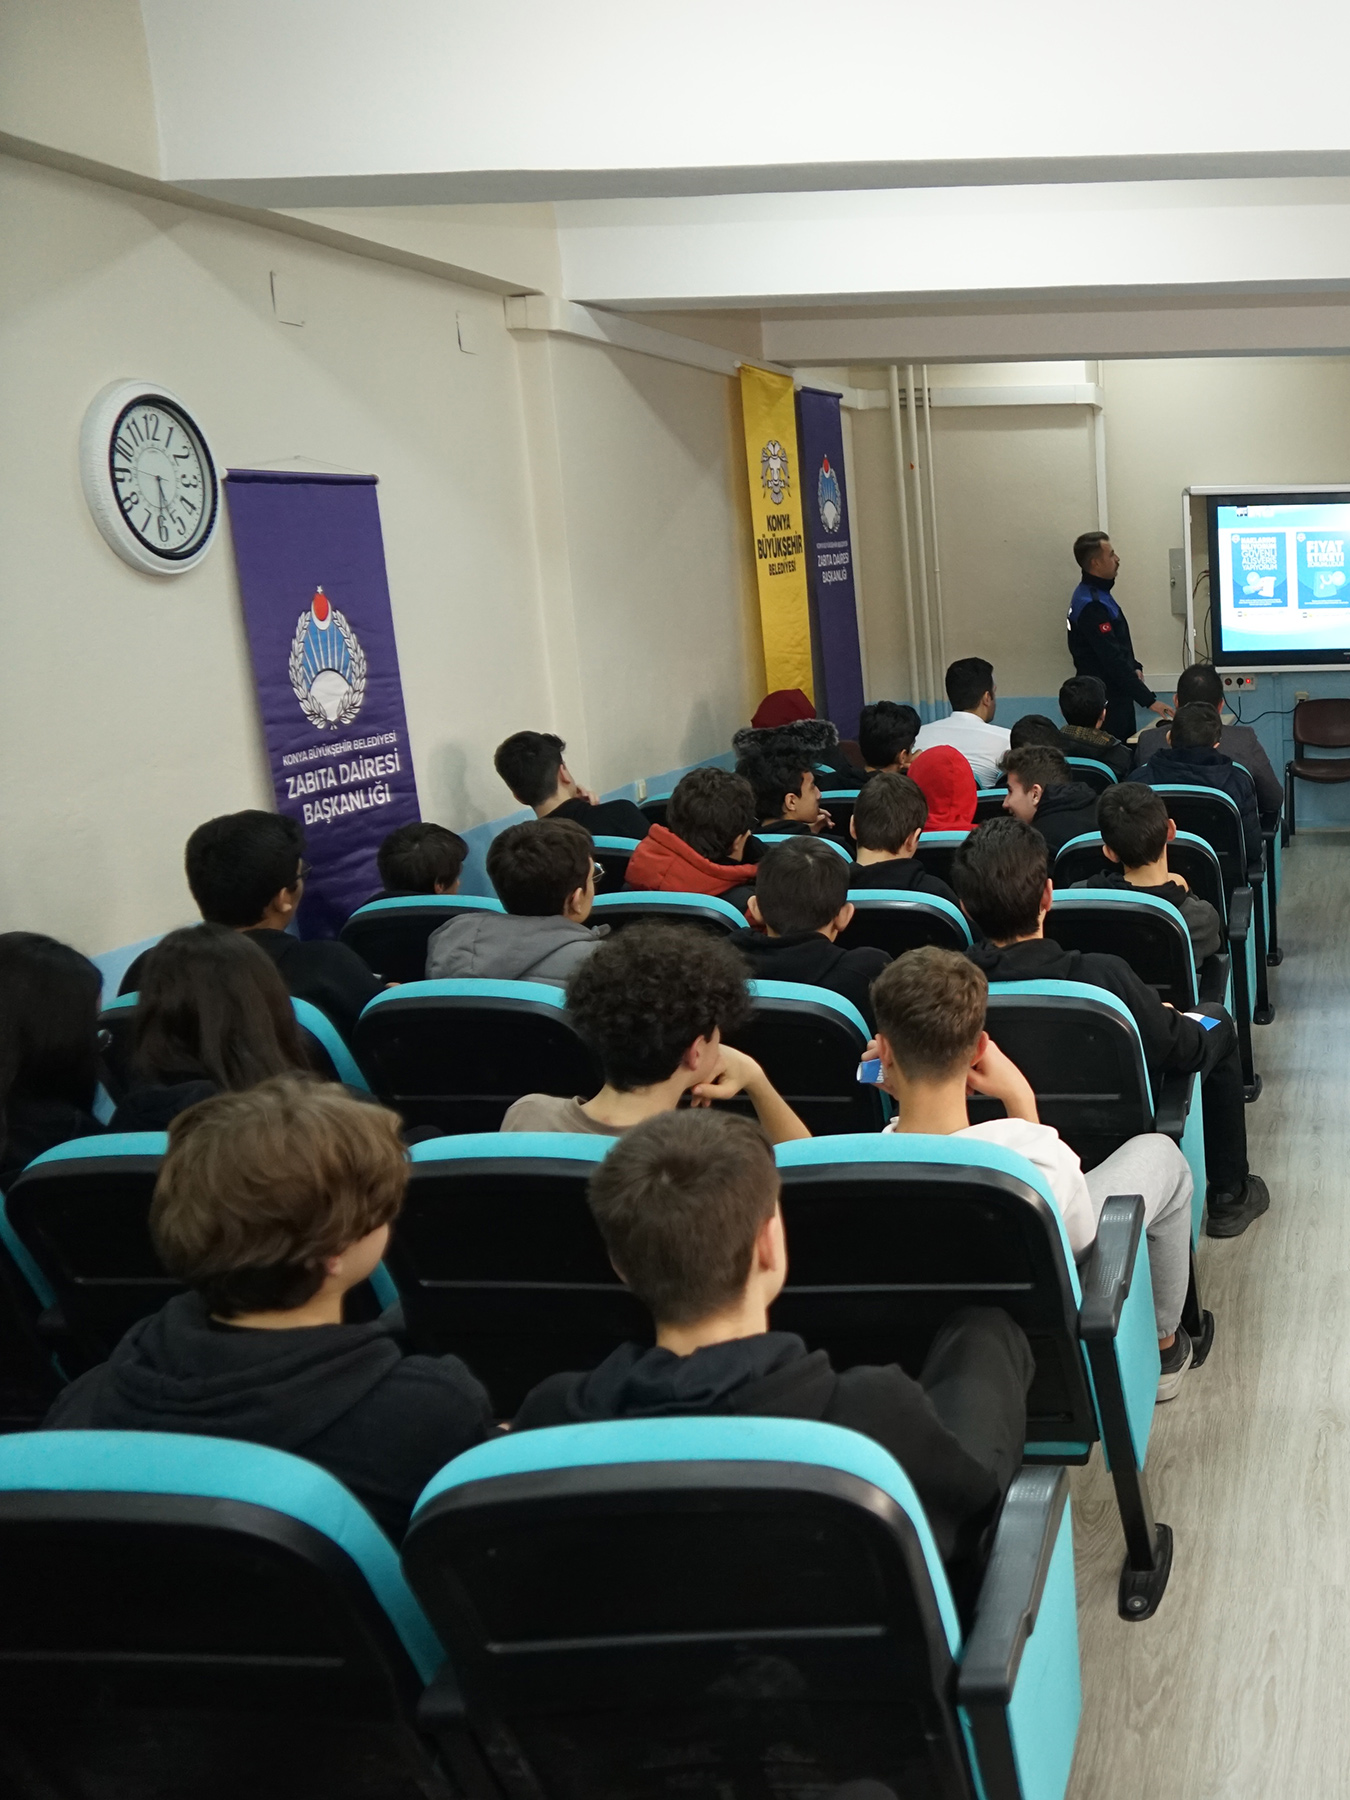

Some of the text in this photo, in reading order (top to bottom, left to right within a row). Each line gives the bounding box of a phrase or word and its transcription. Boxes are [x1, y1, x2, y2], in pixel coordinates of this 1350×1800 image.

[126, 417, 144, 447] 11
[142, 413, 161, 441] 12
[165, 426, 174, 448] 1
[115, 436, 135, 463] 10
[172, 446, 190, 466] 2
[113, 467, 133, 483] 9
[181, 474, 199, 489] 3
[121, 491, 139, 513] 8
[180, 496, 197, 515] 4
[141, 508, 152, 532] 7
[157, 515, 169, 542] 6
[169, 509, 187, 536] 5
[766, 513, 792, 532] KONYA
[757, 530, 803, 560] BÜYÜKŞEHİR
[768, 557, 796, 576] BELEDİYESİ
[817, 553, 833, 567] ZABITA
[282, 729, 397, 766] KONYA BÜYÜKŞEHİR BELEDİYESİ
[285, 747, 400, 799] ZABITA DAİRESİ
[302, 780, 391, 825] BAŞKANLIĞI
